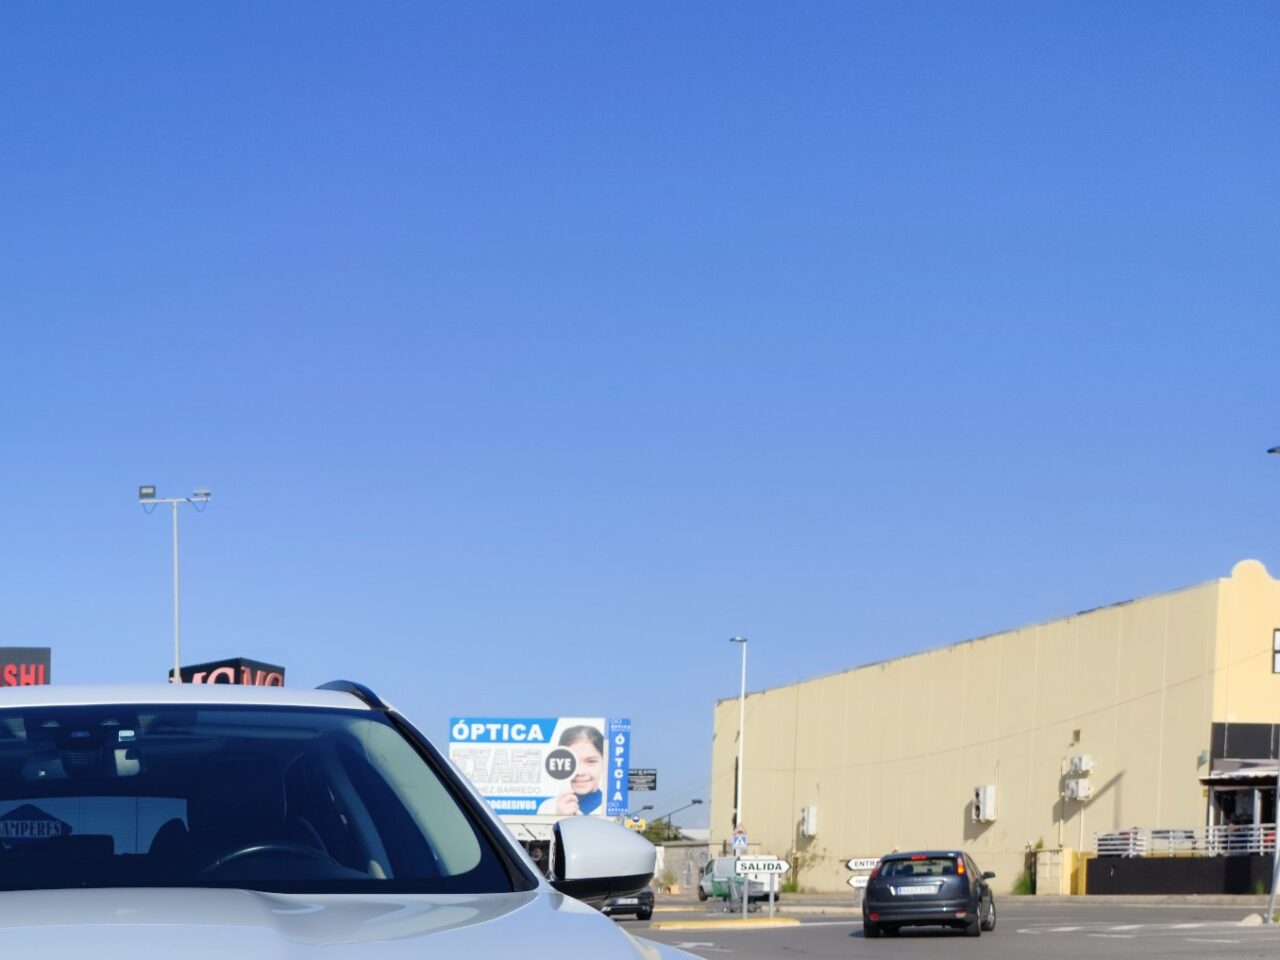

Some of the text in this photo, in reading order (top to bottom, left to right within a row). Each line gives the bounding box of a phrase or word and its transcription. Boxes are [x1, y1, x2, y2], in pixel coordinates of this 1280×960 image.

[452, 719, 544, 741] ÓPTICA
[549, 757, 571, 771] EYE
[497, 785, 541, 794] BARREDO
[740, 862, 783, 871] SALIDA
